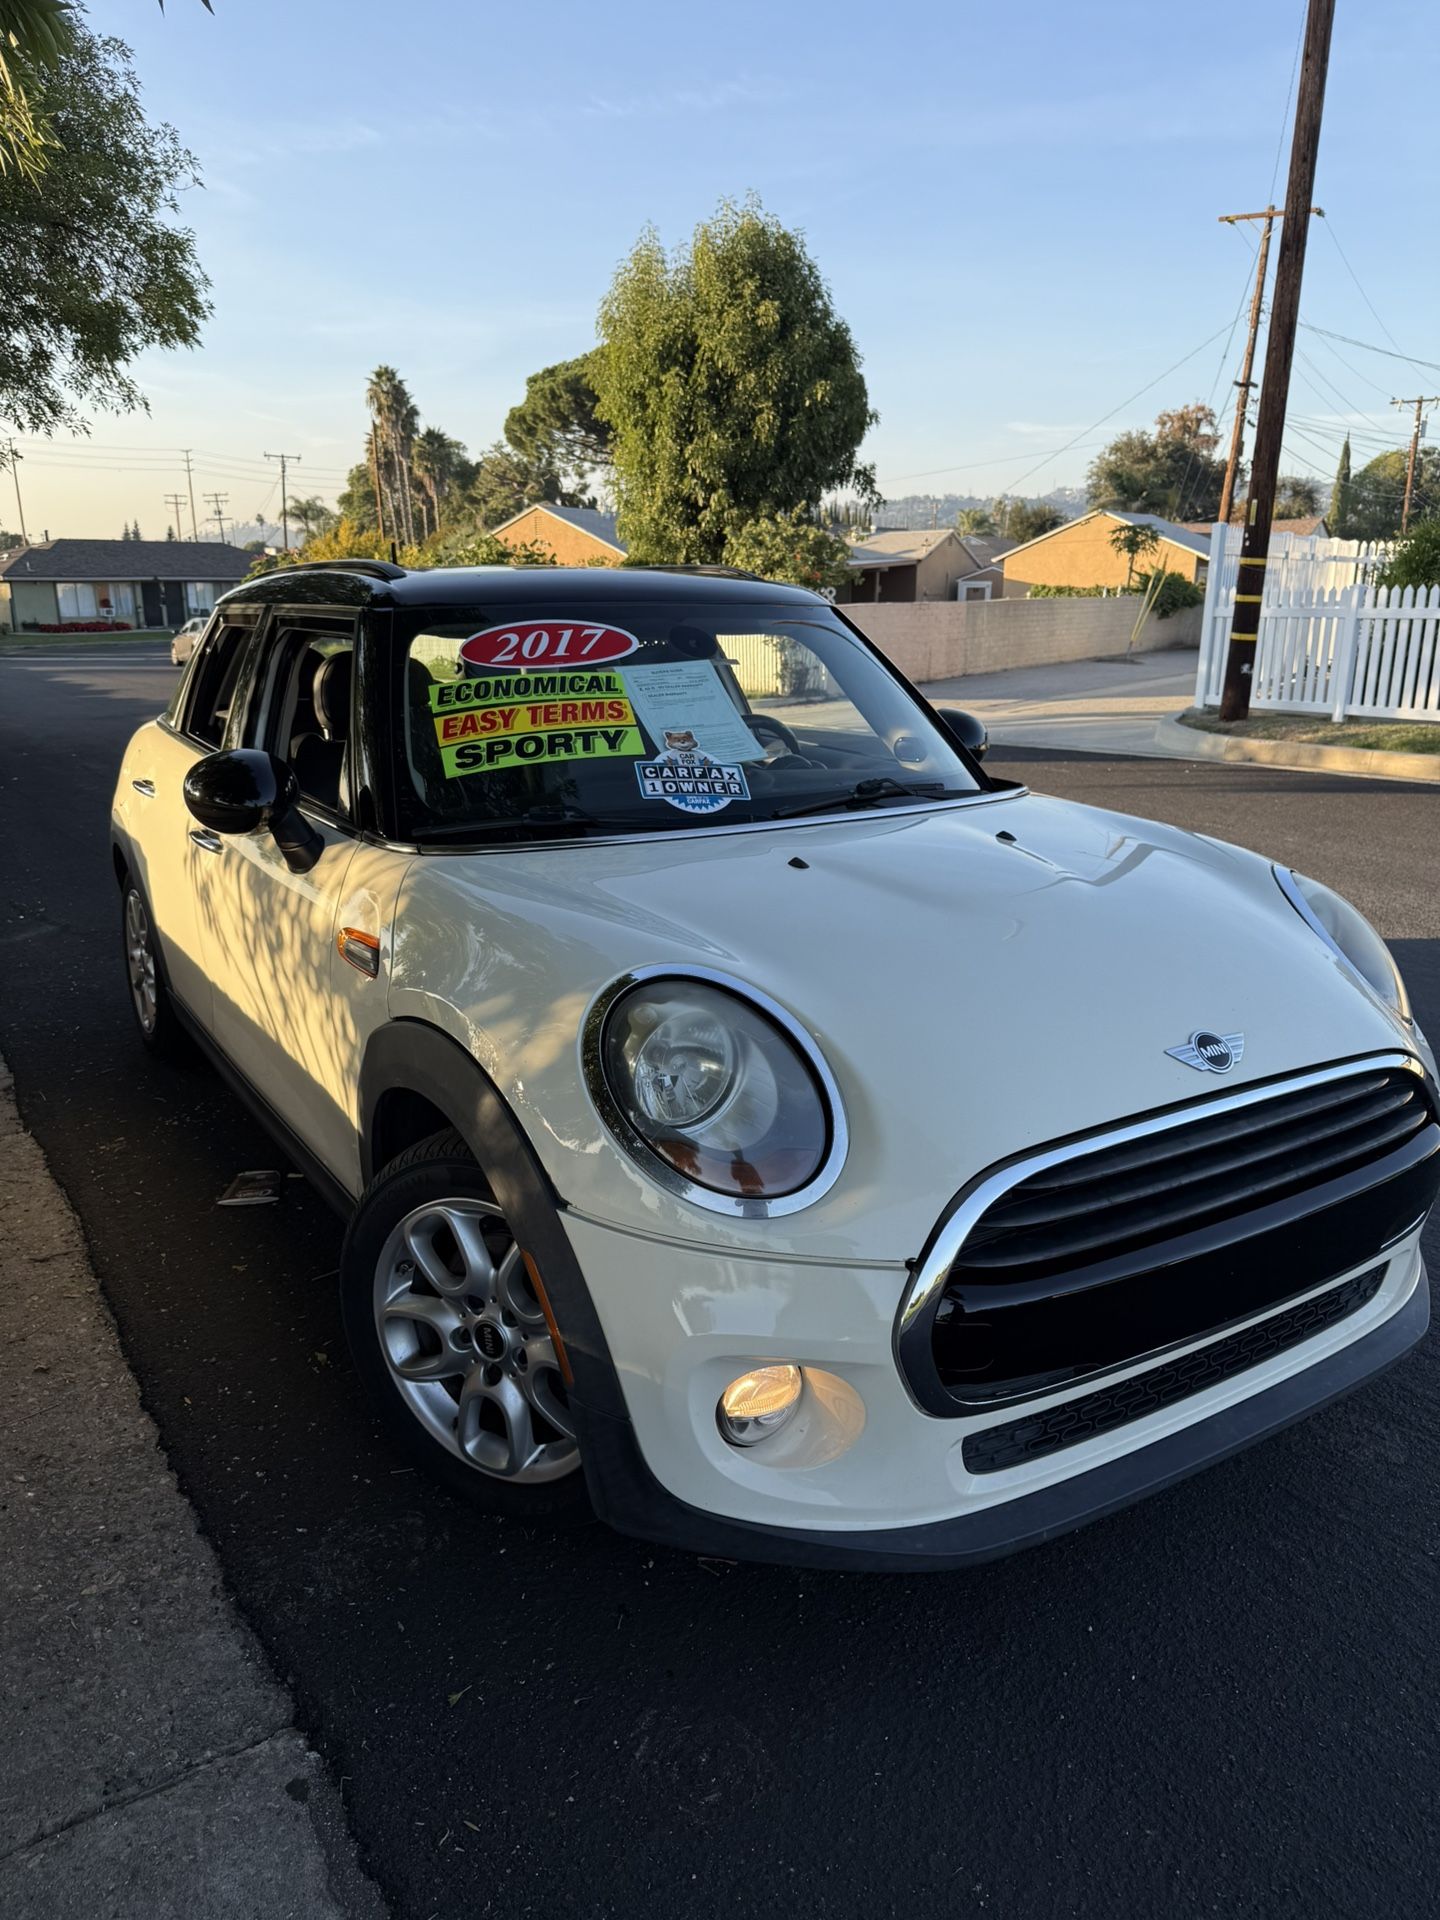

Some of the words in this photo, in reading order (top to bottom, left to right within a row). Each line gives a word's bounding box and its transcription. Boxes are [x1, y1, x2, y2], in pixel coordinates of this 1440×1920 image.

[490, 628, 608, 664] 2017
[437, 675, 622, 707] ECONOMICAL
[441, 708, 520, 742] EASY
[527, 700, 627, 727] TERMS
[454, 729, 629, 771] SPORTY
[644, 767, 738, 781] CARFAX
[1200, 1043, 1229, 1058] MINI
[483, 1327, 495, 1354] MINI
